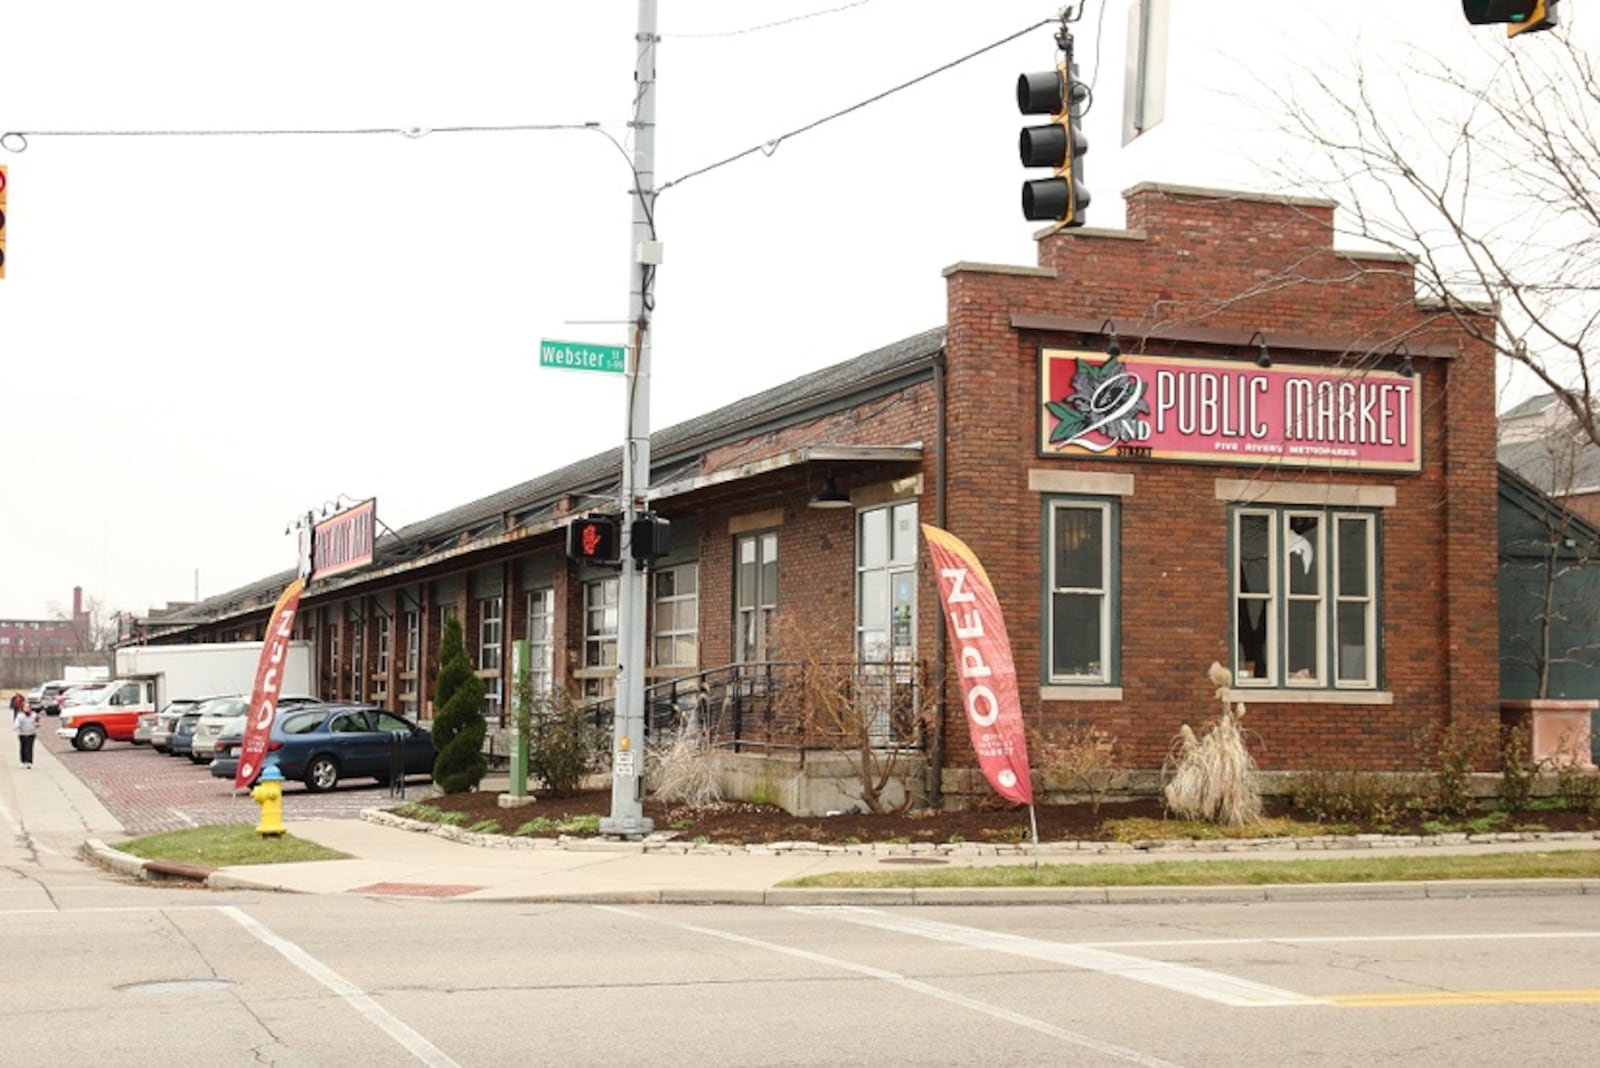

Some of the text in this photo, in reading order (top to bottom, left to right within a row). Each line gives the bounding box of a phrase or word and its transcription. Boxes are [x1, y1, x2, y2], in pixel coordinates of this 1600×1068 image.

[543, 346, 604, 367] Webster
[1157, 371, 1412, 446] PUBLIC MARKET
[1117, 446, 1152, 458] STREET
[1214, 441, 1357, 457] FIVE RIVERS METROPARKS
[940, 567, 1000, 727] OPEN
